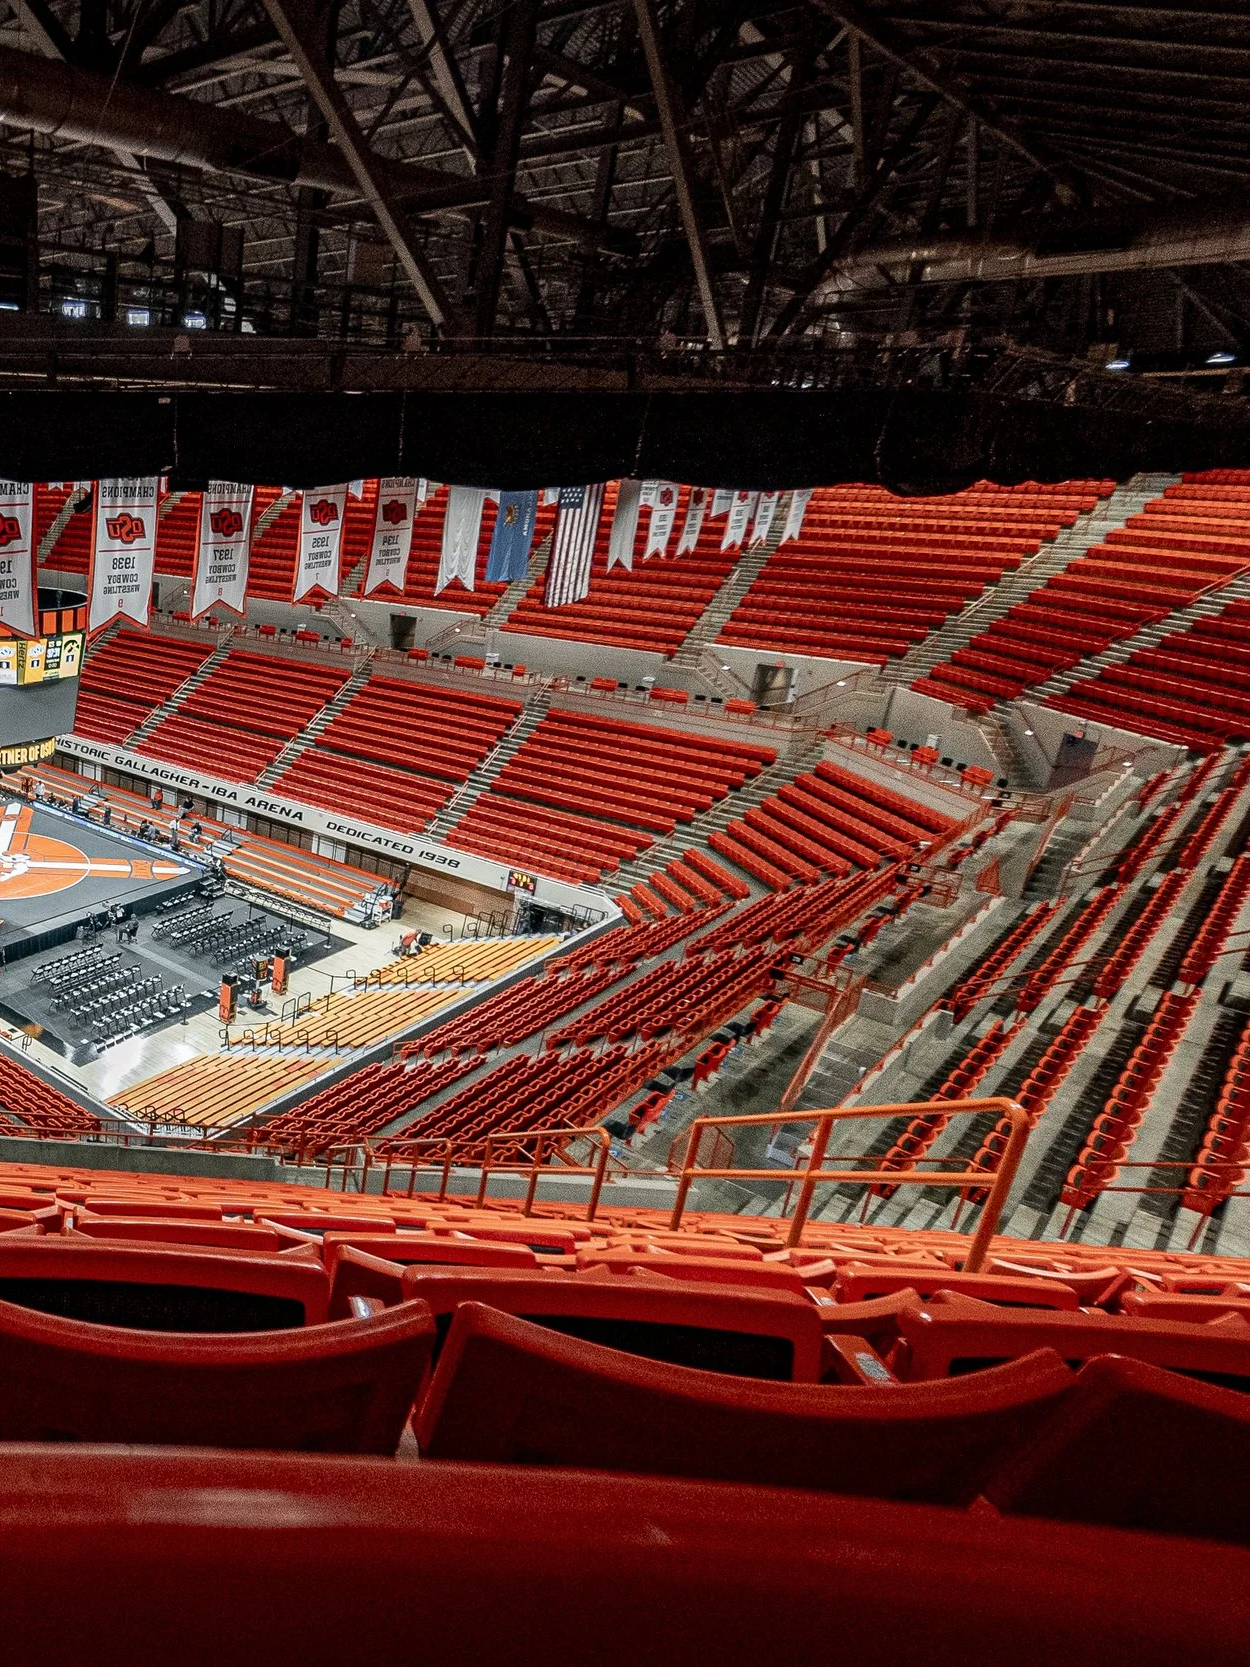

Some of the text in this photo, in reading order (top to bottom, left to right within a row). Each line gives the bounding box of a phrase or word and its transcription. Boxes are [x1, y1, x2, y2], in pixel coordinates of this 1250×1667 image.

[18, 642, 27, 668] Hertz
[28, 745, 40, 762] OF
[244, 797, 304, 822] ARENA
[326, 820, 414, 855] DEDICATED
[418, 850, 461, 870] 1938
